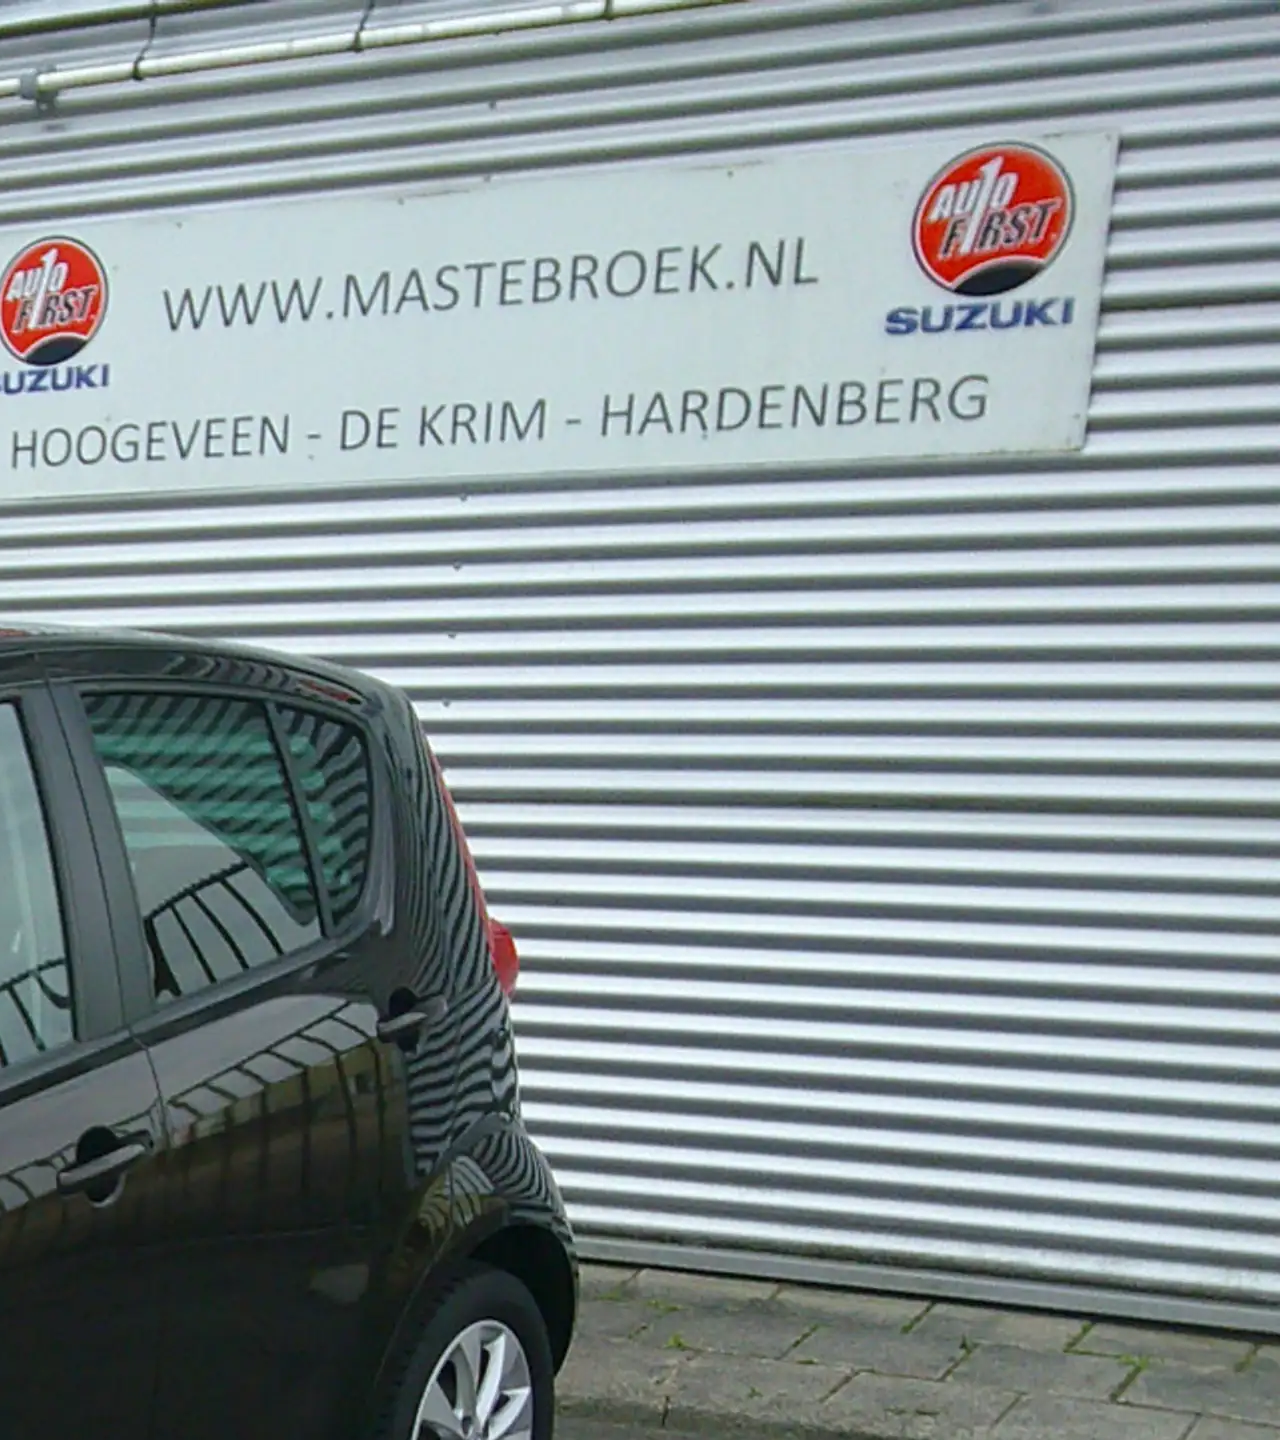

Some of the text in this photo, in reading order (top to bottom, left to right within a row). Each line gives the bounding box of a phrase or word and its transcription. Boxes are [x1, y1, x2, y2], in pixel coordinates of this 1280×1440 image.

[162, 236, 820, 333] WWW.MASTEBROEK.NL
[884, 298, 1076, 336] SUZUKI
[11, 414, 290, 469] HOOGEVEEN
[340, 407, 401, 451] DE
[419, 398, 547, 447] KRIM
[600, 374, 990, 437] HARDENBERG
